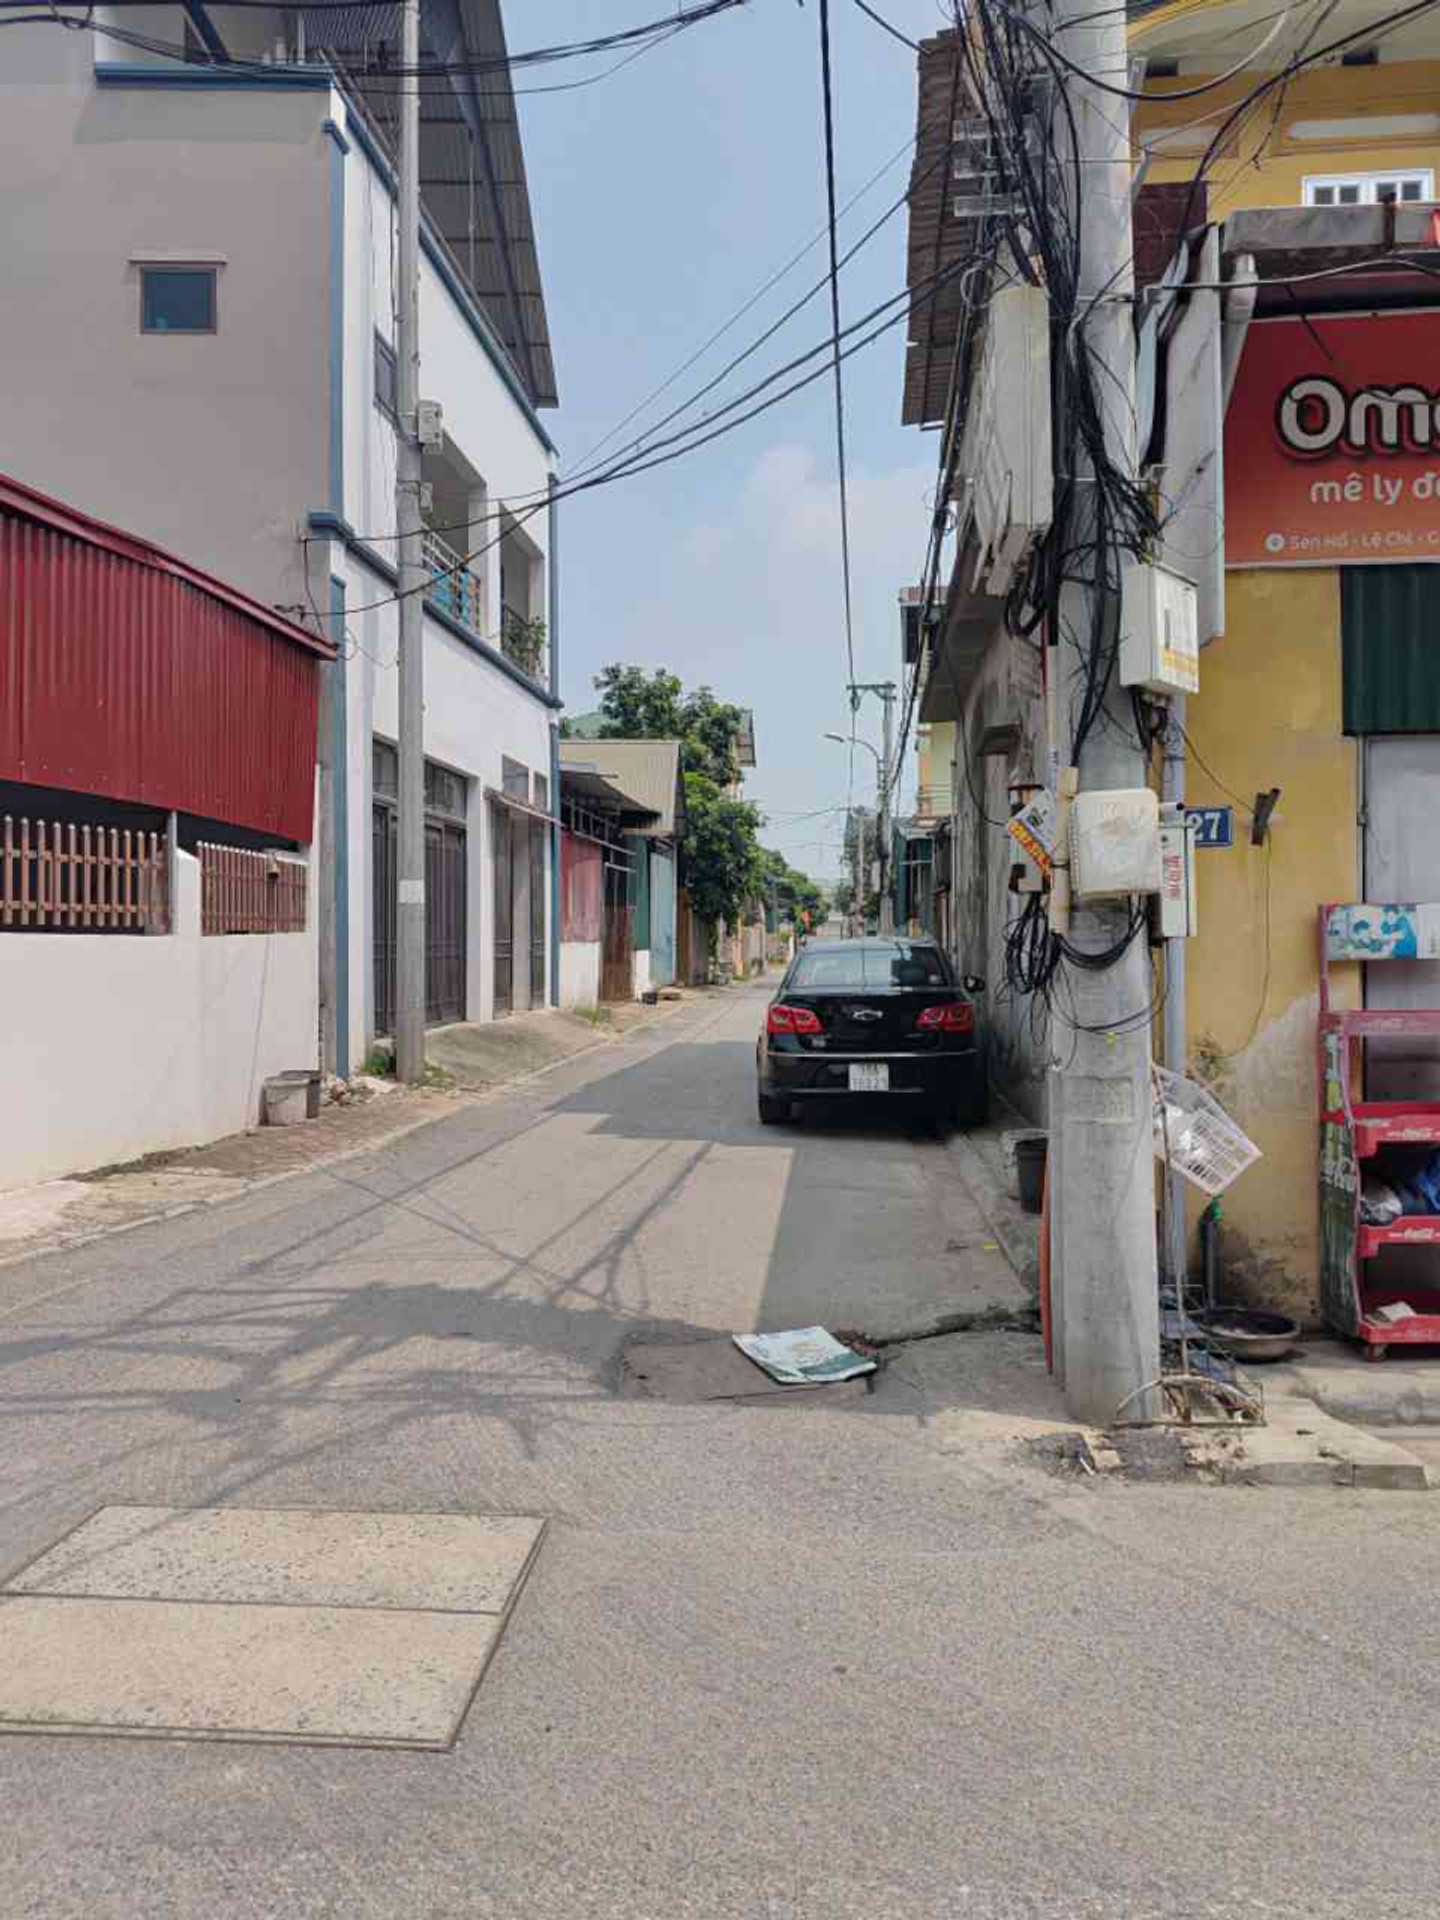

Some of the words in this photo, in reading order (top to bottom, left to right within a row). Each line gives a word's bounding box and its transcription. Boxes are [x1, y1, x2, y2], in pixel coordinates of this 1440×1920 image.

[1310, 471, 1363, 504] mê
[1373, 472, 1404, 505] ly
[1187, 811, 1222, 841] 27
